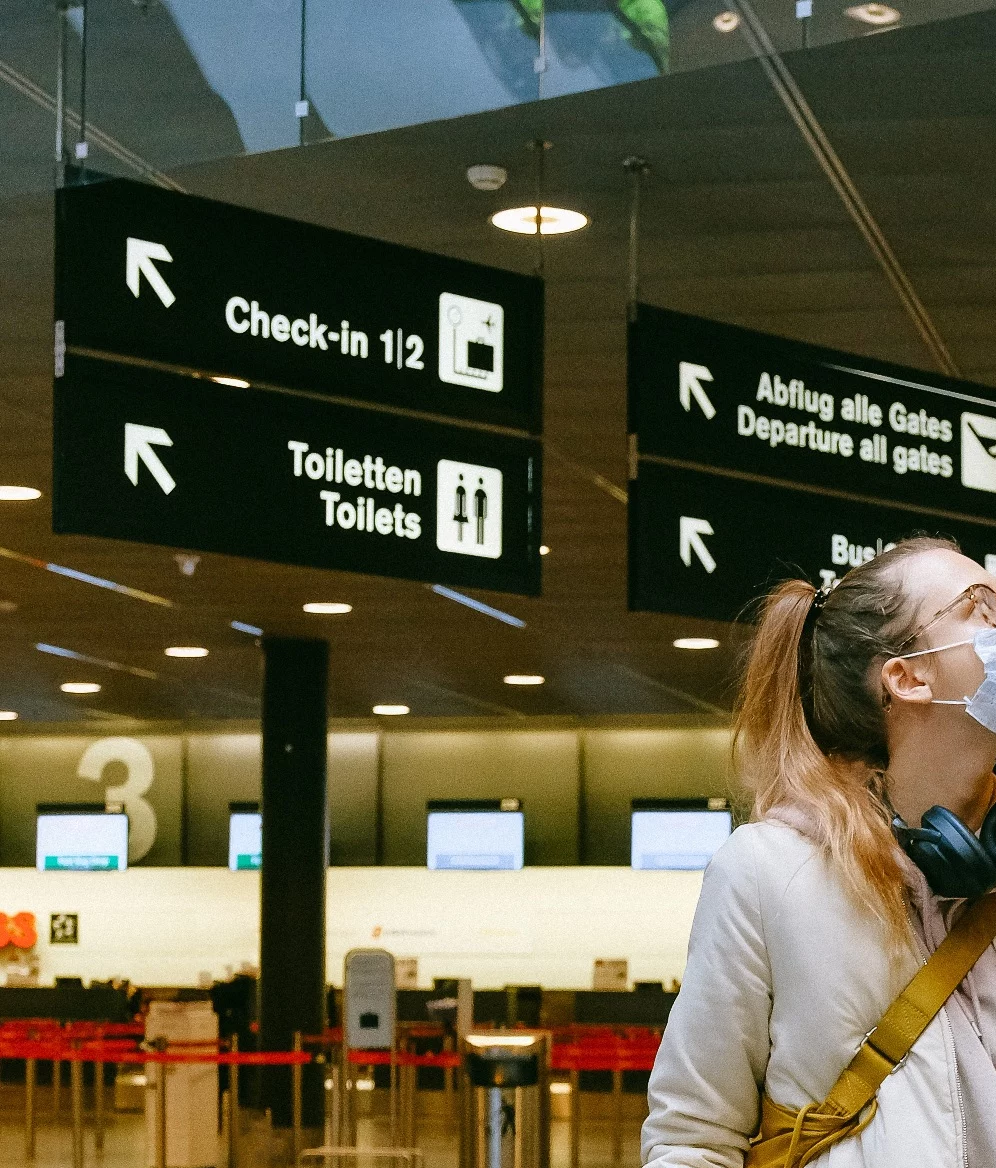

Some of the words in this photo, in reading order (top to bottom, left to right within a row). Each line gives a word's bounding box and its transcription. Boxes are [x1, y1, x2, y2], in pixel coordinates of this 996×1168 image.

[225, 295, 369, 359] Check-in
[756, 371, 834, 422] Abflug
[840, 393, 883, 428] alle
[888, 401, 953, 443] Gates
[287, 440, 422, 497] Toiletten
[737, 404, 854, 458] Departure
[859, 433, 888, 465] all
[892, 444, 954, 479] gates
[319, 489, 422, 540] Toilets
[77, 736, 158, 866] 3
